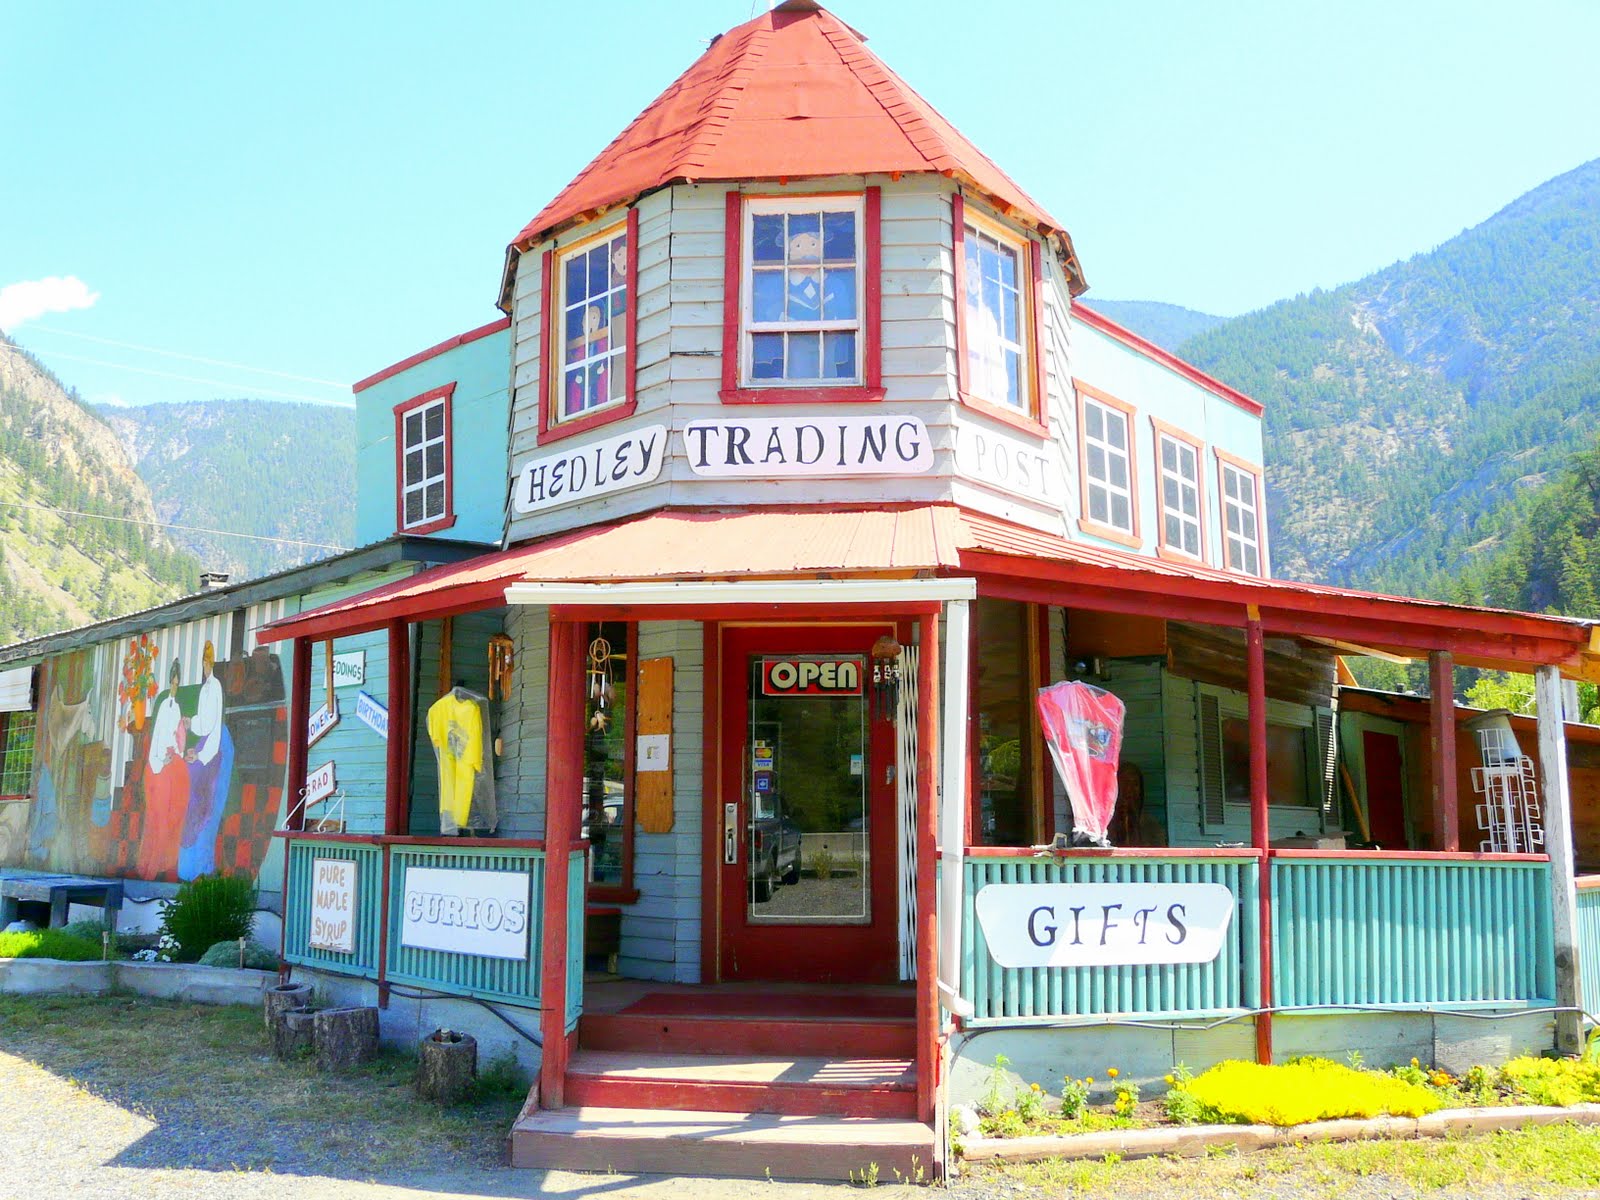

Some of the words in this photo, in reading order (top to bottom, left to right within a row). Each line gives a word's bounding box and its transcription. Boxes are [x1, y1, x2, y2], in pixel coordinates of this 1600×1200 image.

[687, 421, 920, 467] TRADING
[528, 432, 656, 503] HEDLEY
[975, 434, 1050, 496] POST
[332, 660, 362, 680] EDDINGS
[770, 661, 858, 689] OPEN
[359, 699, 388, 733] BIRTHDA
[319, 865, 346, 888] PURE
[316, 890, 348, 911] MAPLE
[404, 891, 525, 934] CURIOS
[315, 917, 347, 942] SYRUP
[1028, 904, 1187, 946] GIFTS
